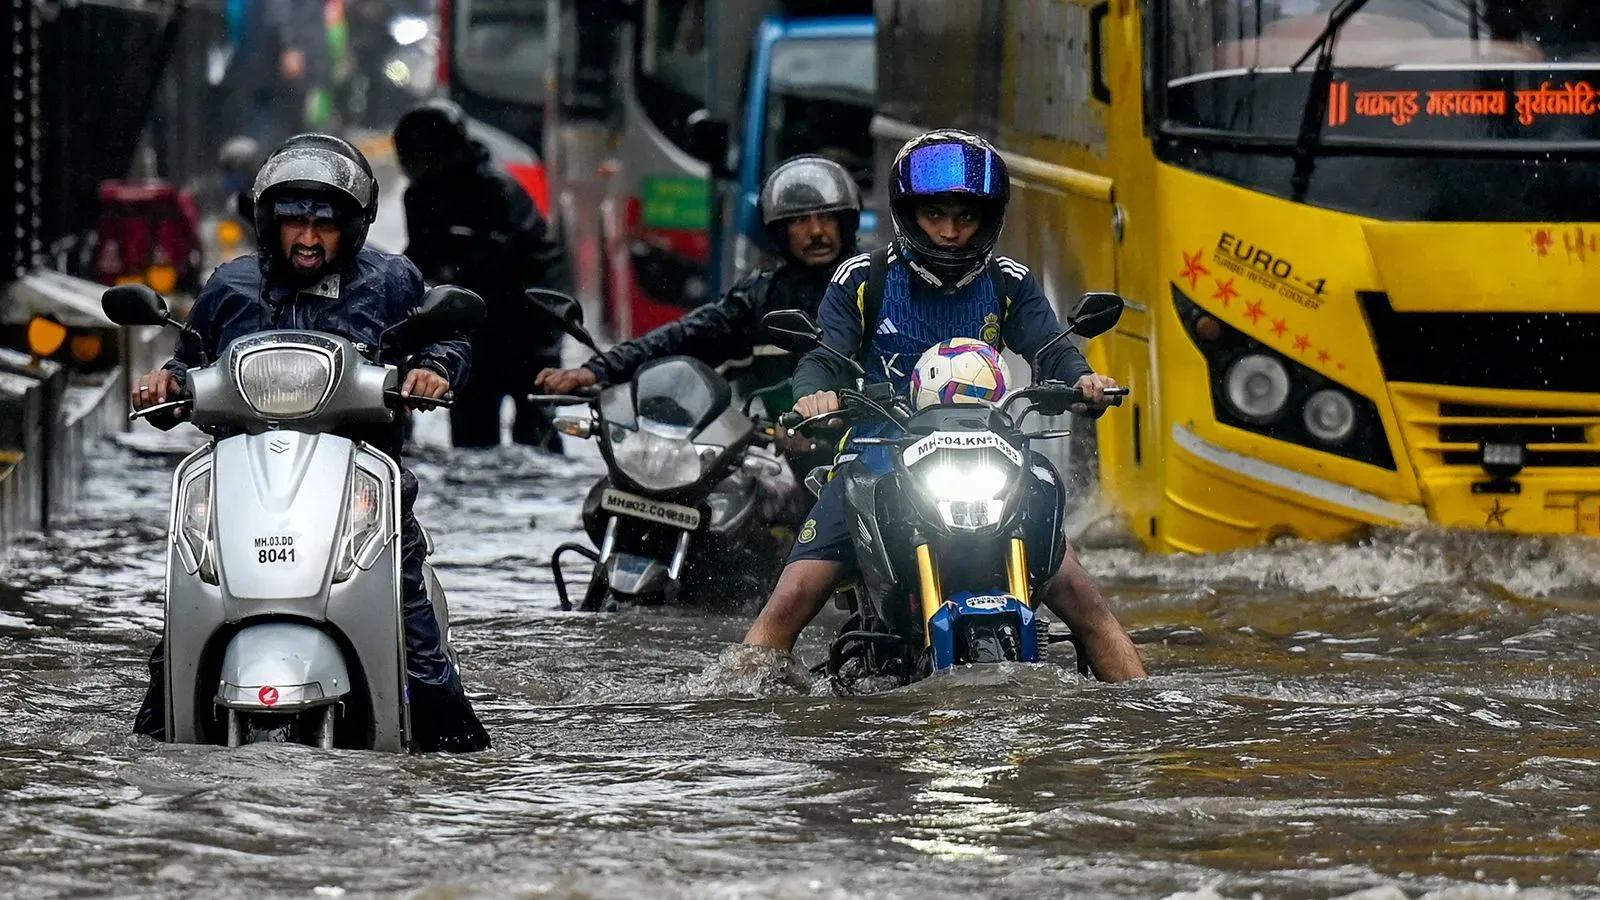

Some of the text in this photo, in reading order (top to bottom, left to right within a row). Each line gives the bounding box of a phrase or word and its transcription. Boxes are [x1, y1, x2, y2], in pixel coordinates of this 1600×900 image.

[1426, 90, 1506, 117] महाकाय
[1213, 254, 1320, 311] TURBO INTER COOLER
[254, 536, 294, 548] MH.03.DD
[258, 548, 295, 564] 8041
